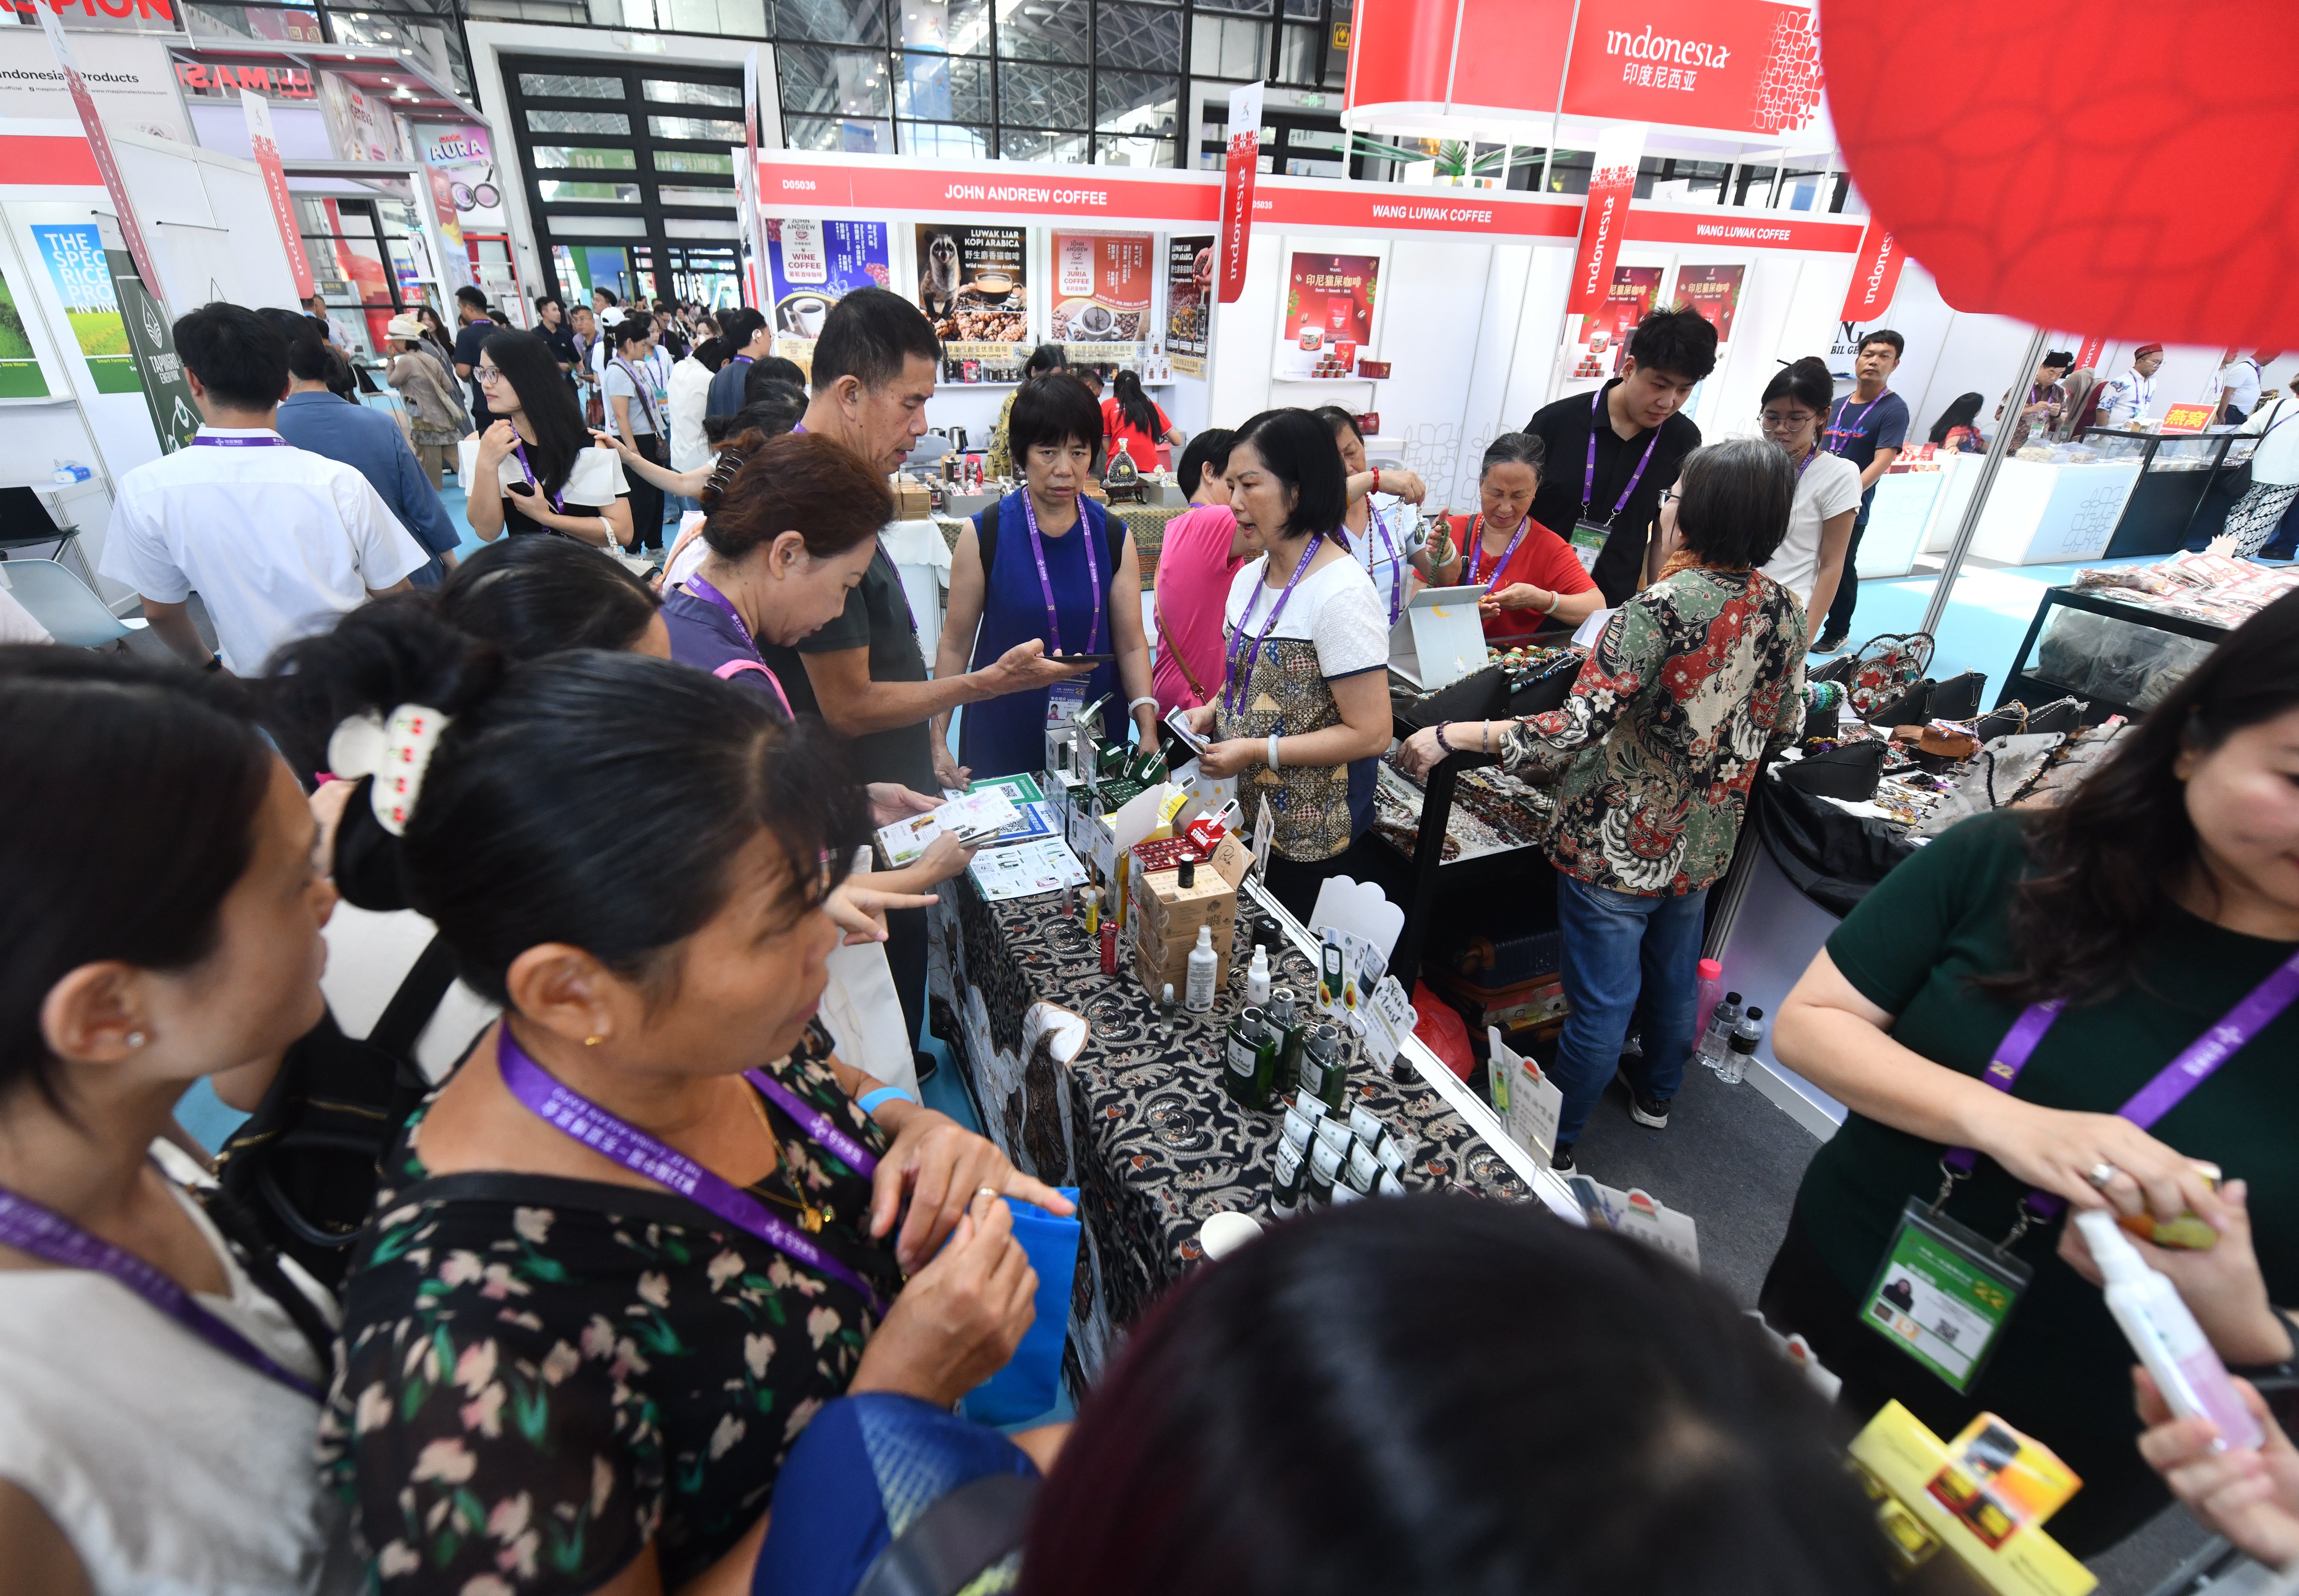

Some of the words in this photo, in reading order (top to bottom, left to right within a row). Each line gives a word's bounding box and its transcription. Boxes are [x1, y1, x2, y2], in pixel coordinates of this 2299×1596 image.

[1607, 25, 1731, 69] indonesia
[1623, 61, 1698, 92] 印度尼西亚
[430, 139, 484, 161] AURA
[782, 179, 816, 191] D05036
[944, 184, 985, 200] JOHN
[987, 186, 1050, 203] ANDREW
[1052, 189, 1108, 205] COFFEE
[1252, 200, 1273, 210] 05035
[1373, 204, 1407, 219] WANG
[1408, 206, 1448, 221] LUWAK
[1450, 209, 1493, 223] COFFEE
[270, 168, 304, 277] indonesia
[1230, 166, 1246, 280] indonesia
[971, 229, 1000, 238] LUWAK
[1001, 230, 1019, 239] LIAR
[1697, 224, 1724, 236] WANG
[1724, 226, 1756, 239] LUWAK
[1756, 228, 1791, 241] COFFEE
[44, 233, 92, 251] THE
[964, 238, 984, 246] KOPI
[985, 239, 1020, 248] ARABICA
[1586, 194, 1615, 296] indonesia
[965, 250, 1020, 261] 野生麝香猫咖啡
[59, 267, 111, 285] RICE
[1863, 231, 1894, 305] indones
[1305, 274, 1362, 288] 印尼猫屎咖啡
[1688, 282, 1731, 294] 印尼猫屎咖啡
[73, 301, 92, 314] IN
[1830, 346, 1845, 354] BIL
[2164, 408, 2209, 429] 燕窝
[1190, 828, 1209, 847] STRONG
[1988, 1060, 2015, 1080] 22
